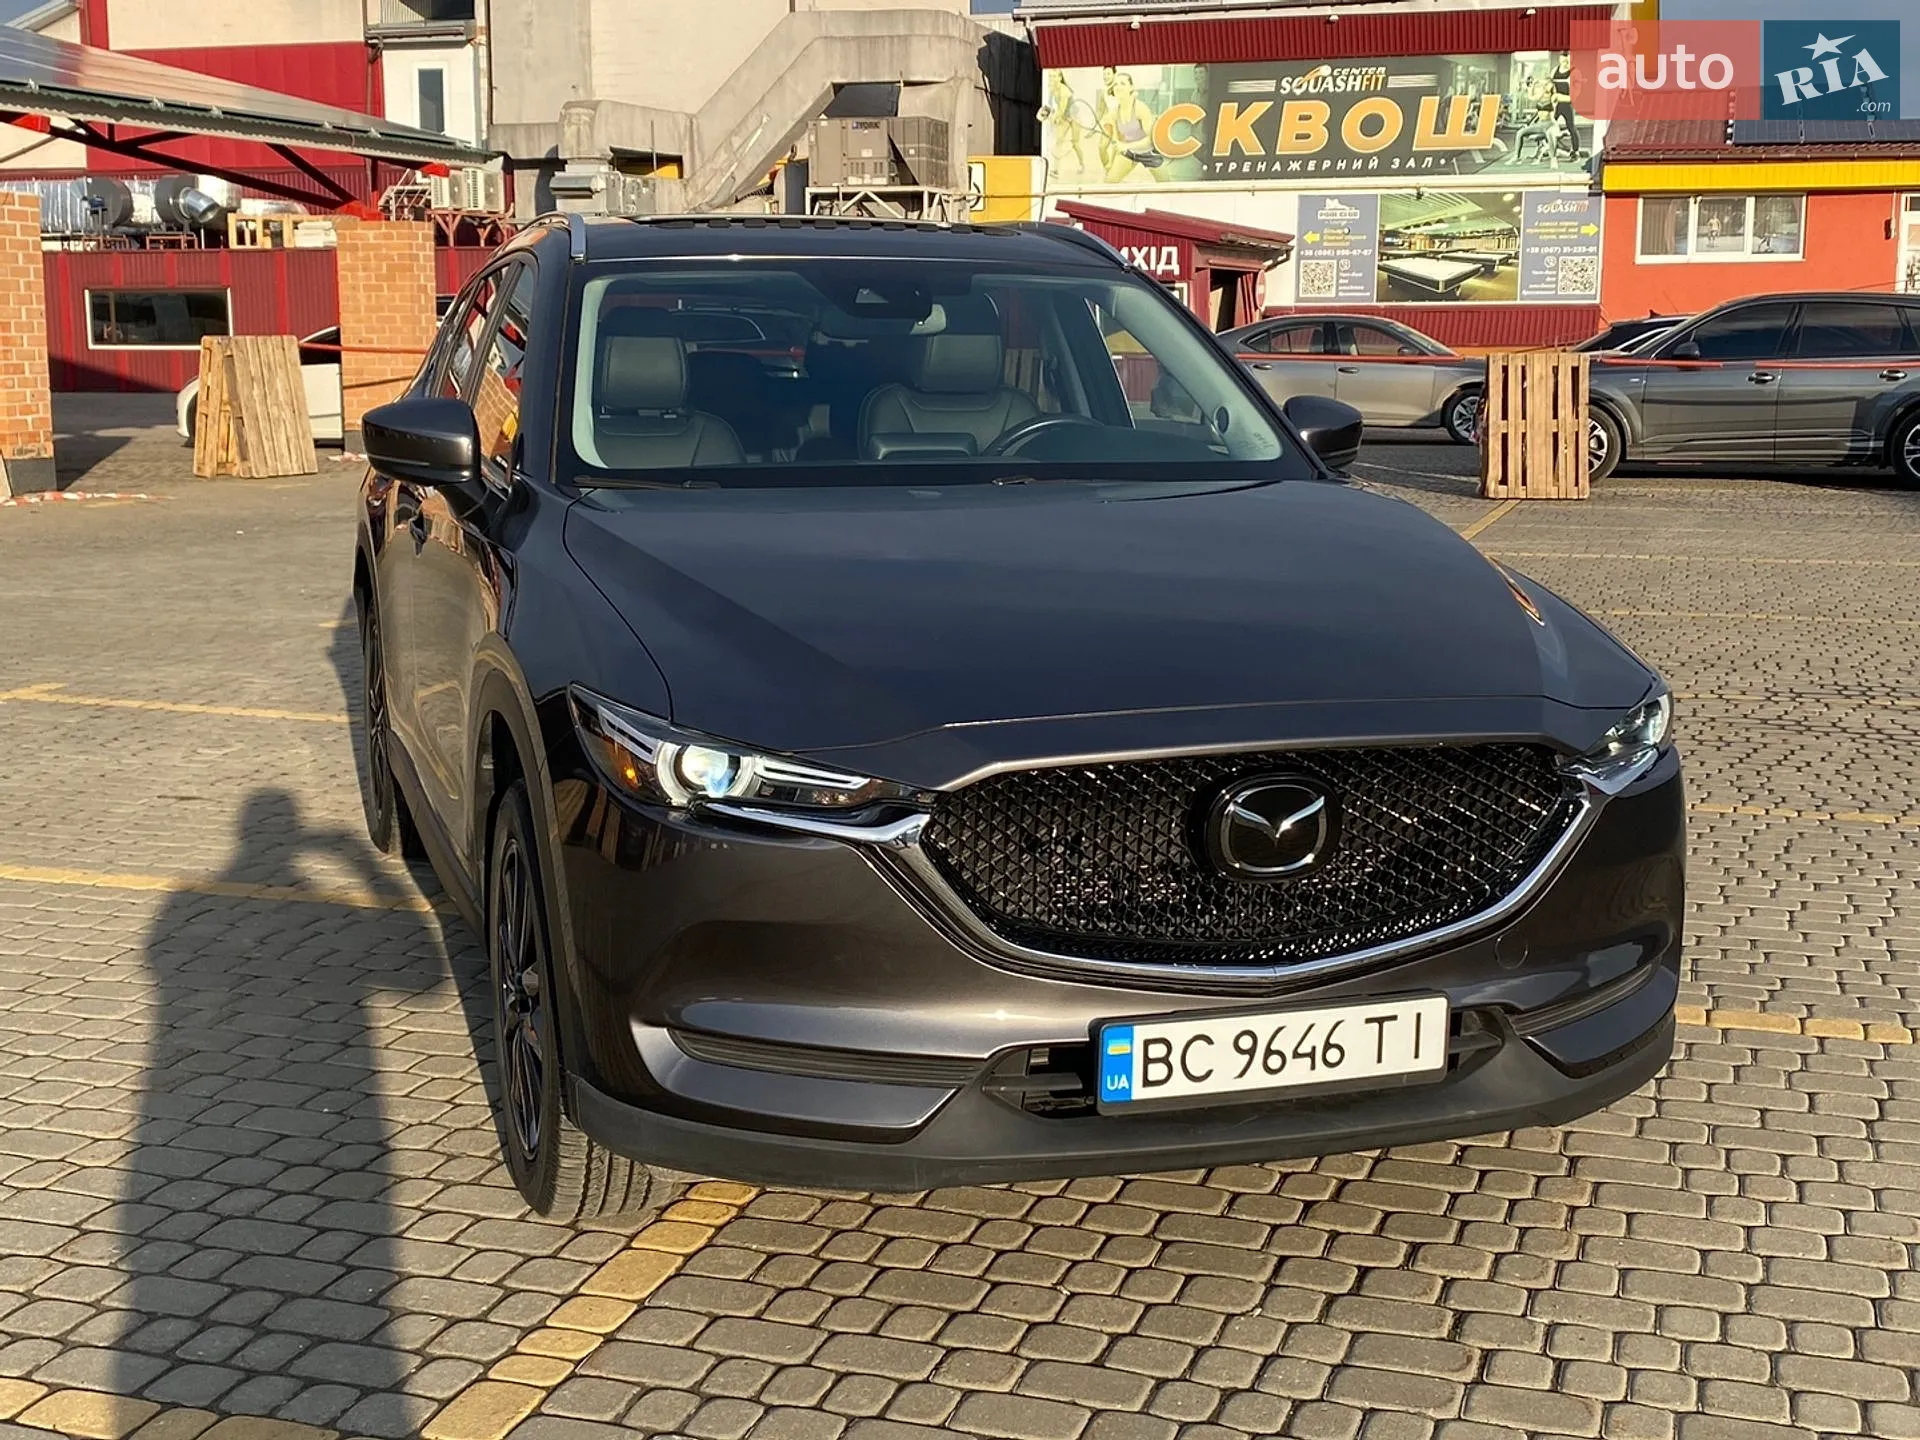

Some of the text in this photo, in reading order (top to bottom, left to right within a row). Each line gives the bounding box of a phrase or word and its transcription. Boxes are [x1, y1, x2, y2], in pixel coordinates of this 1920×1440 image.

[1279, 73, 1386, 96] SQUASHFIT
[1152, 92, 1502, 158] СКВОШ
[1214, 153, 1435, 174] ТРЕНАЖЕРНИЙ ЗАЛ
[1141, 1011, 1422, 1088] BC 9646 TI
[1105, 1074, 1130, 1092] UA
